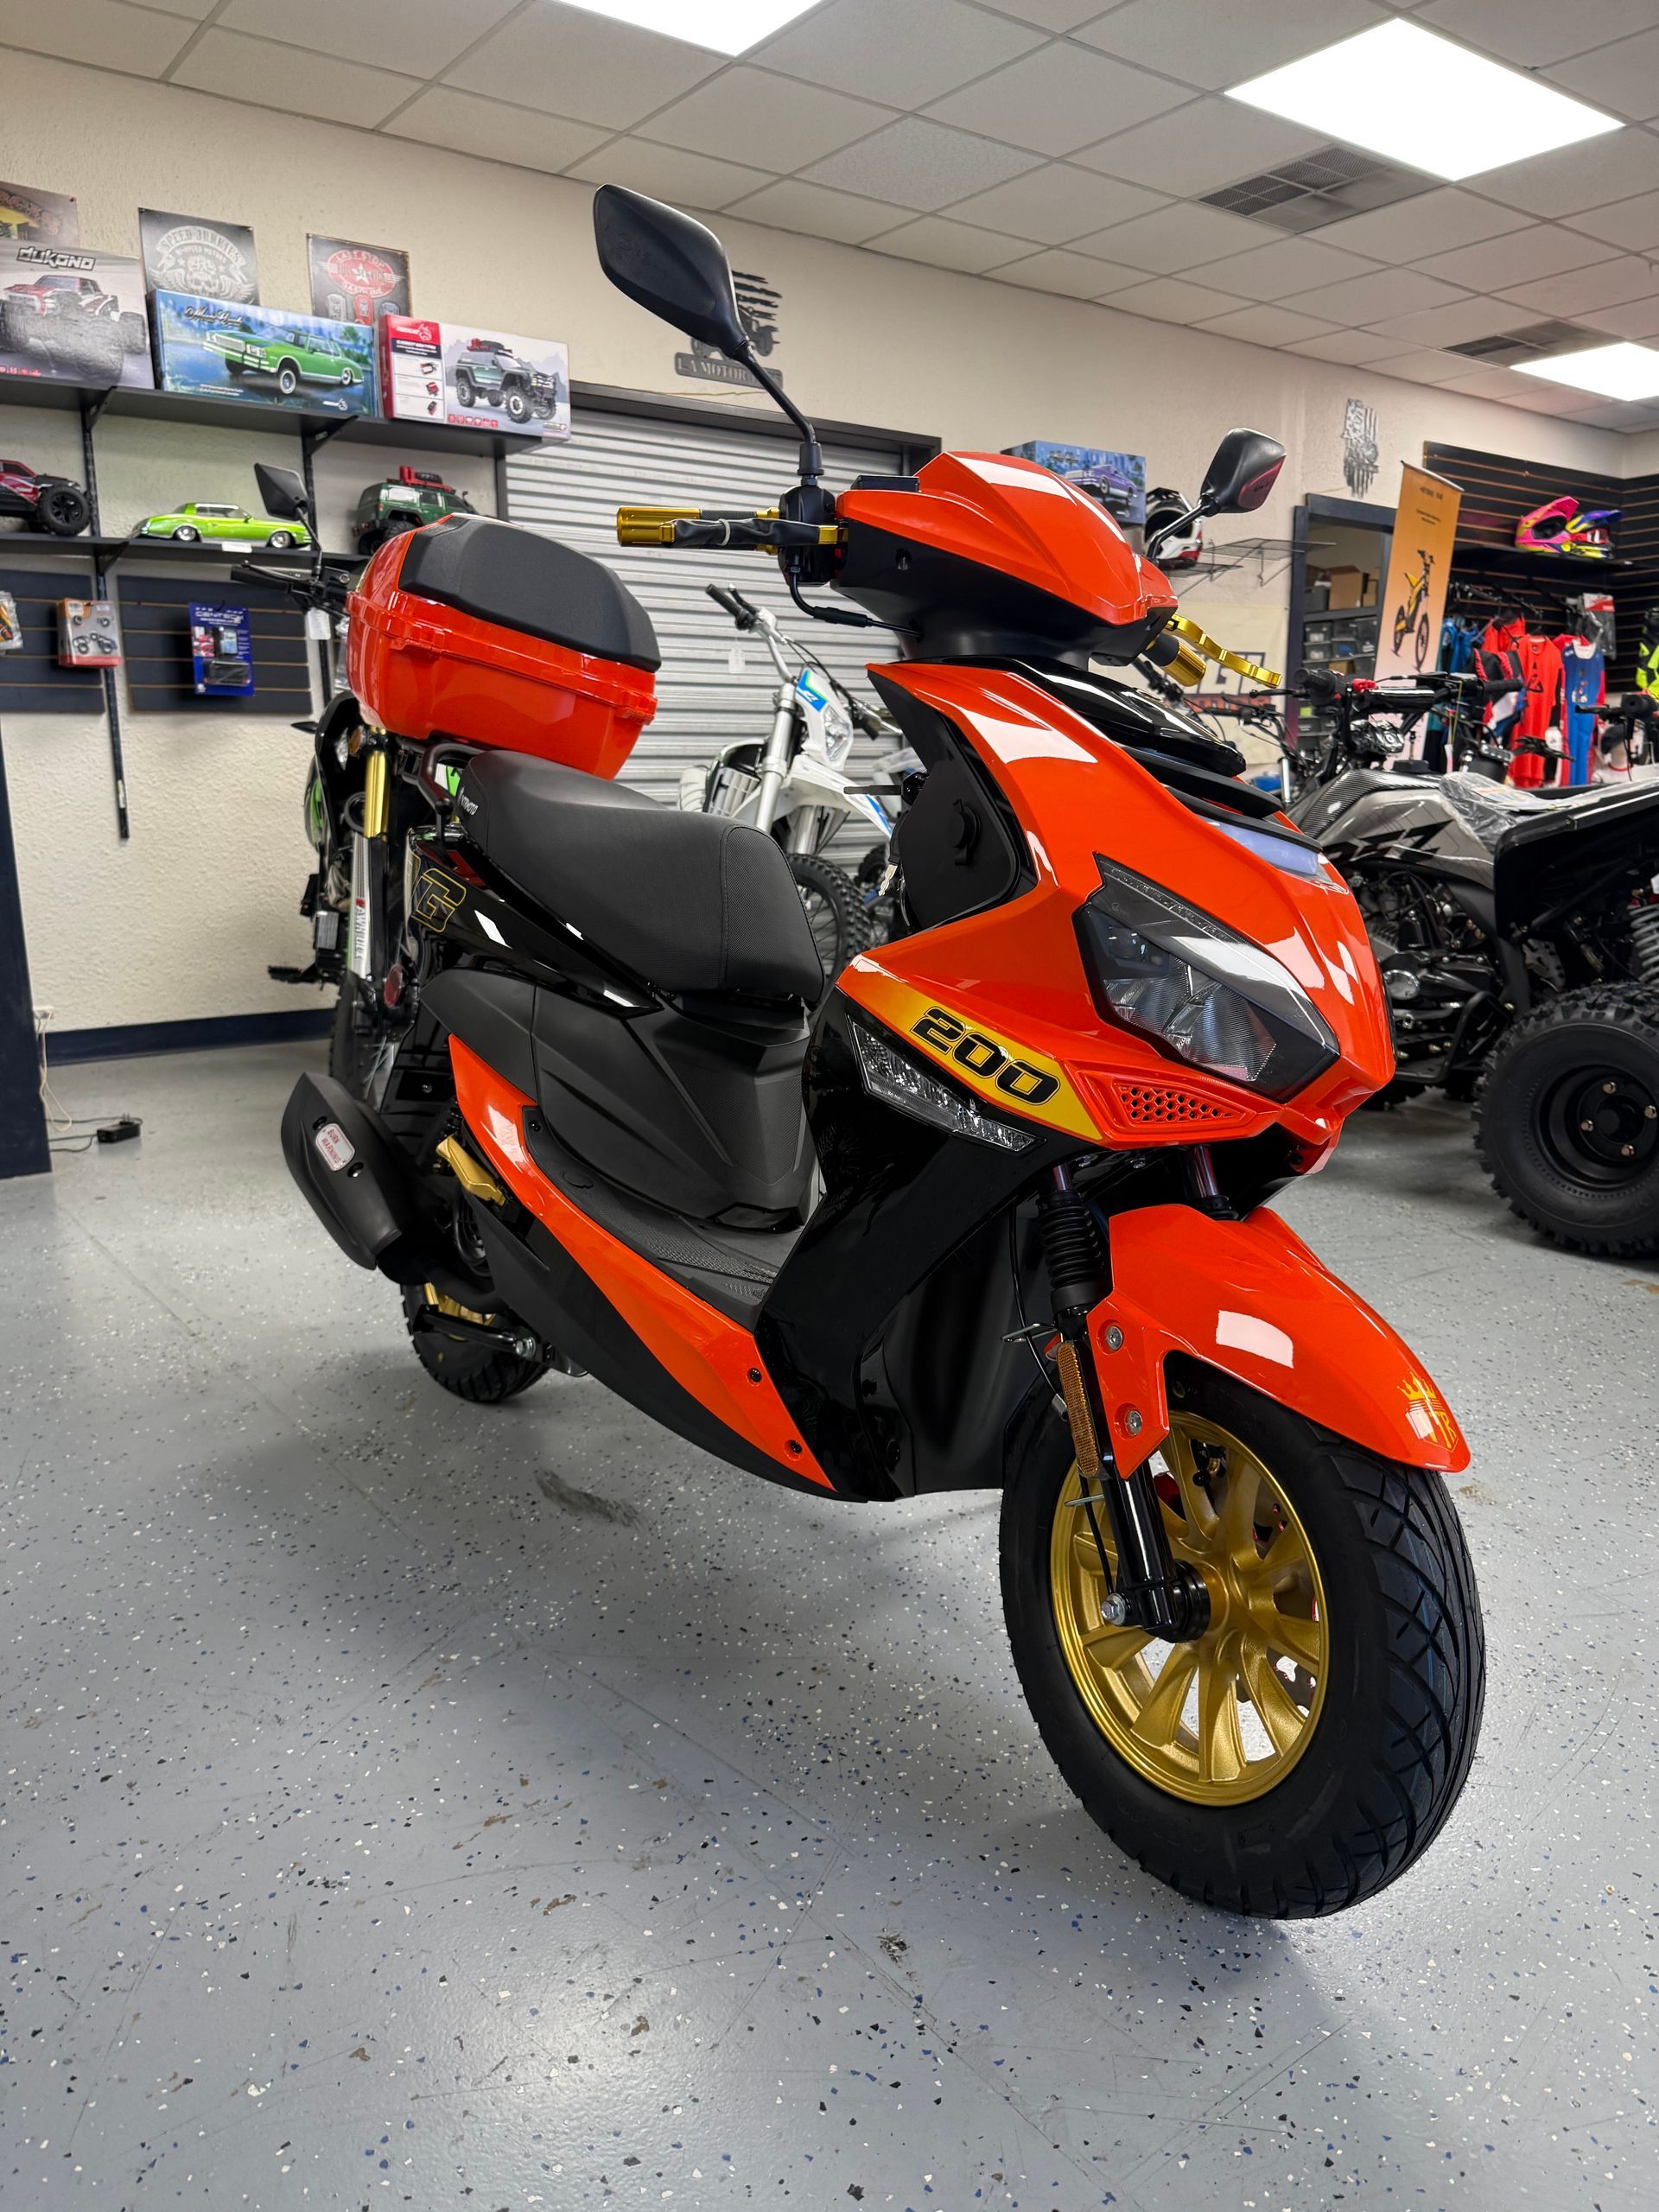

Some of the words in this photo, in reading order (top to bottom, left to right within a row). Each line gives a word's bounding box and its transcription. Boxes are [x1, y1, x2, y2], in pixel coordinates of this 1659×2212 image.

[701, 361, 747, 381] MOTOR
[909, 1006, 1061, 1107] 200
[327, 1128, 340, 1145] BURN
[321, 1137, 342, 1164] WARNING
